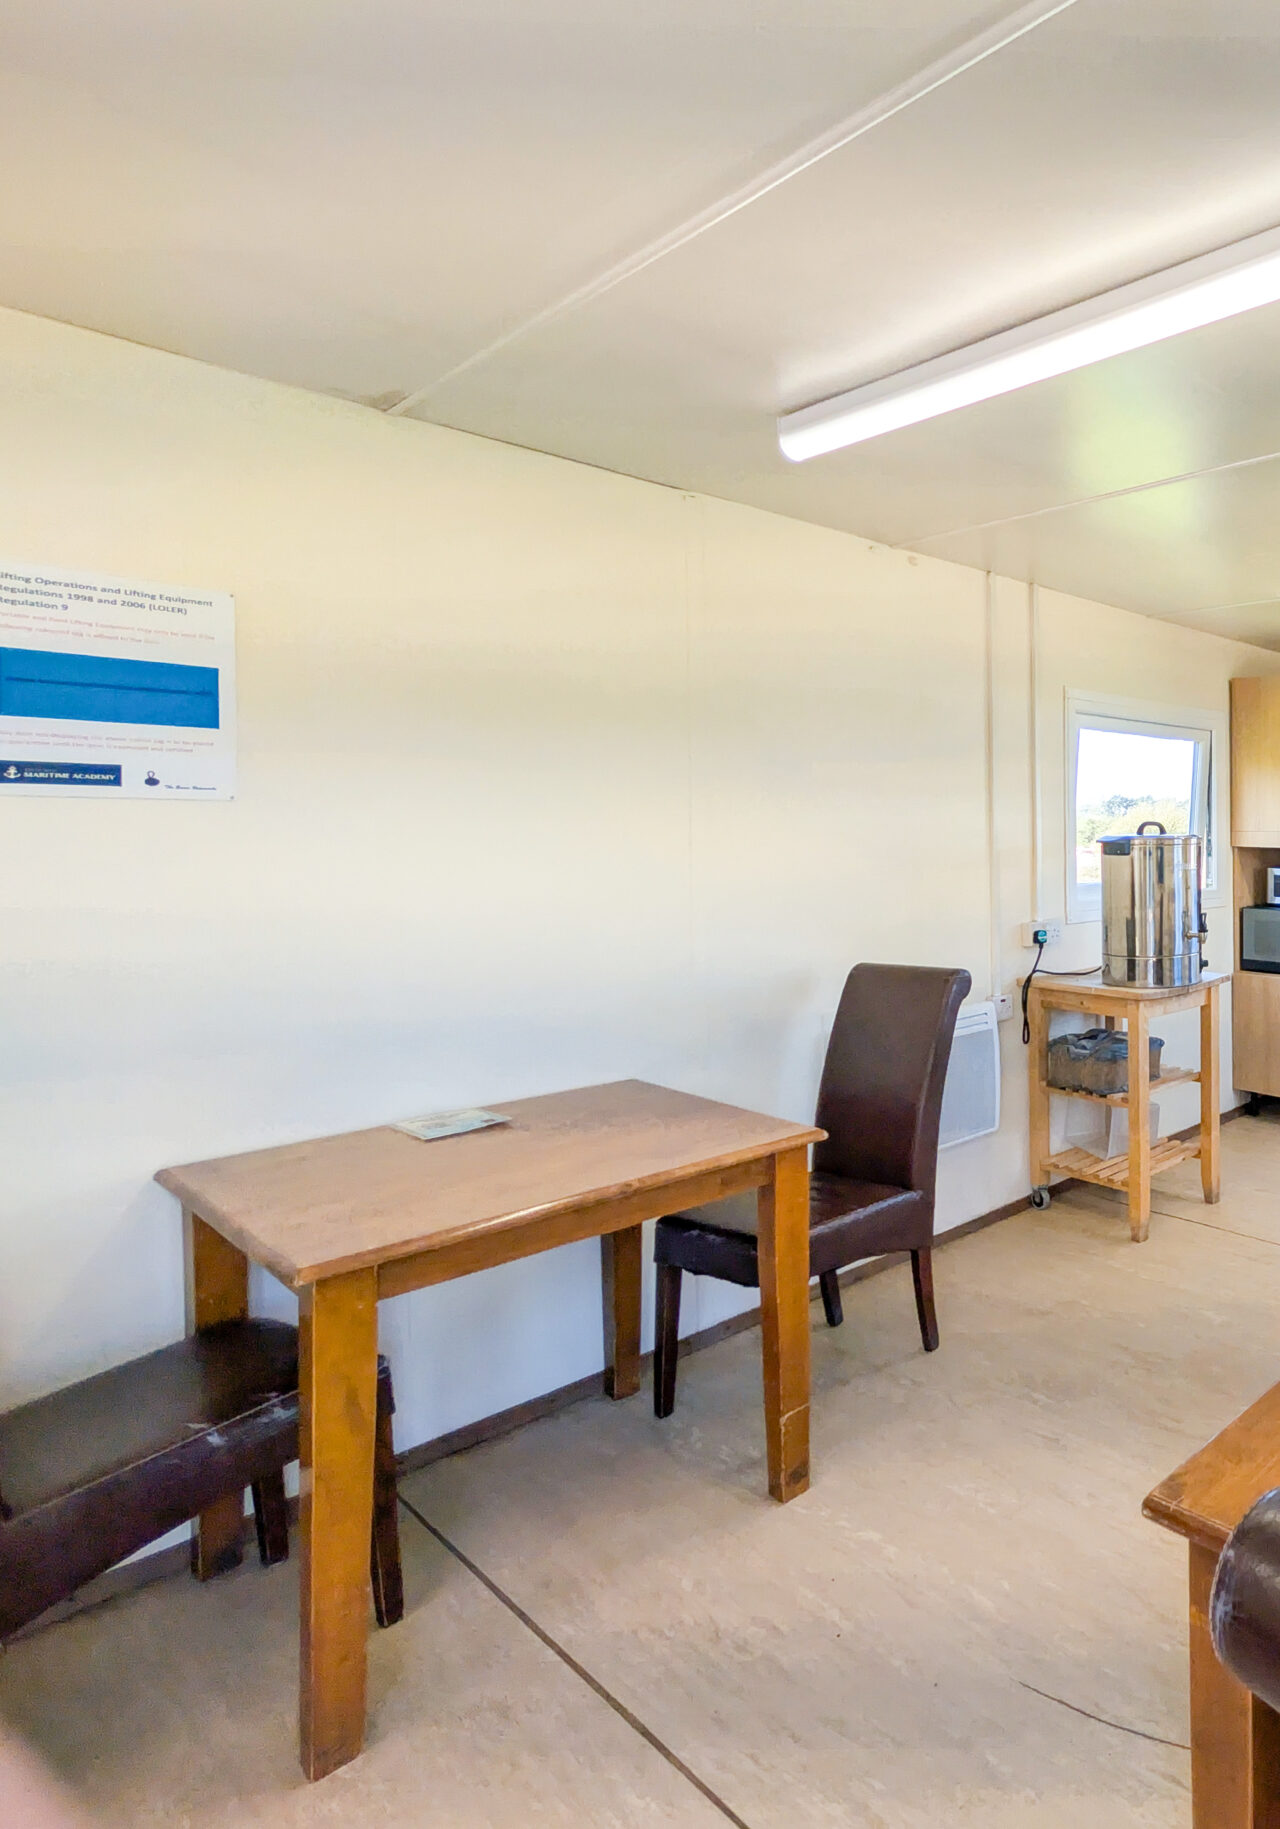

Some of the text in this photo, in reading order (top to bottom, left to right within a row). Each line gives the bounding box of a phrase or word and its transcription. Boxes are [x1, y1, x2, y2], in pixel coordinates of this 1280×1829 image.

[0, 571, 213, 607] ifting Operations and Lifting Equipment
[67, 593, 94, 602] 1998
[120, 600, 146, 609] 2006
[149, 603, 187, 615] (LOLER)
[23, 771, 116, 781] MARITIME ACADEMY
